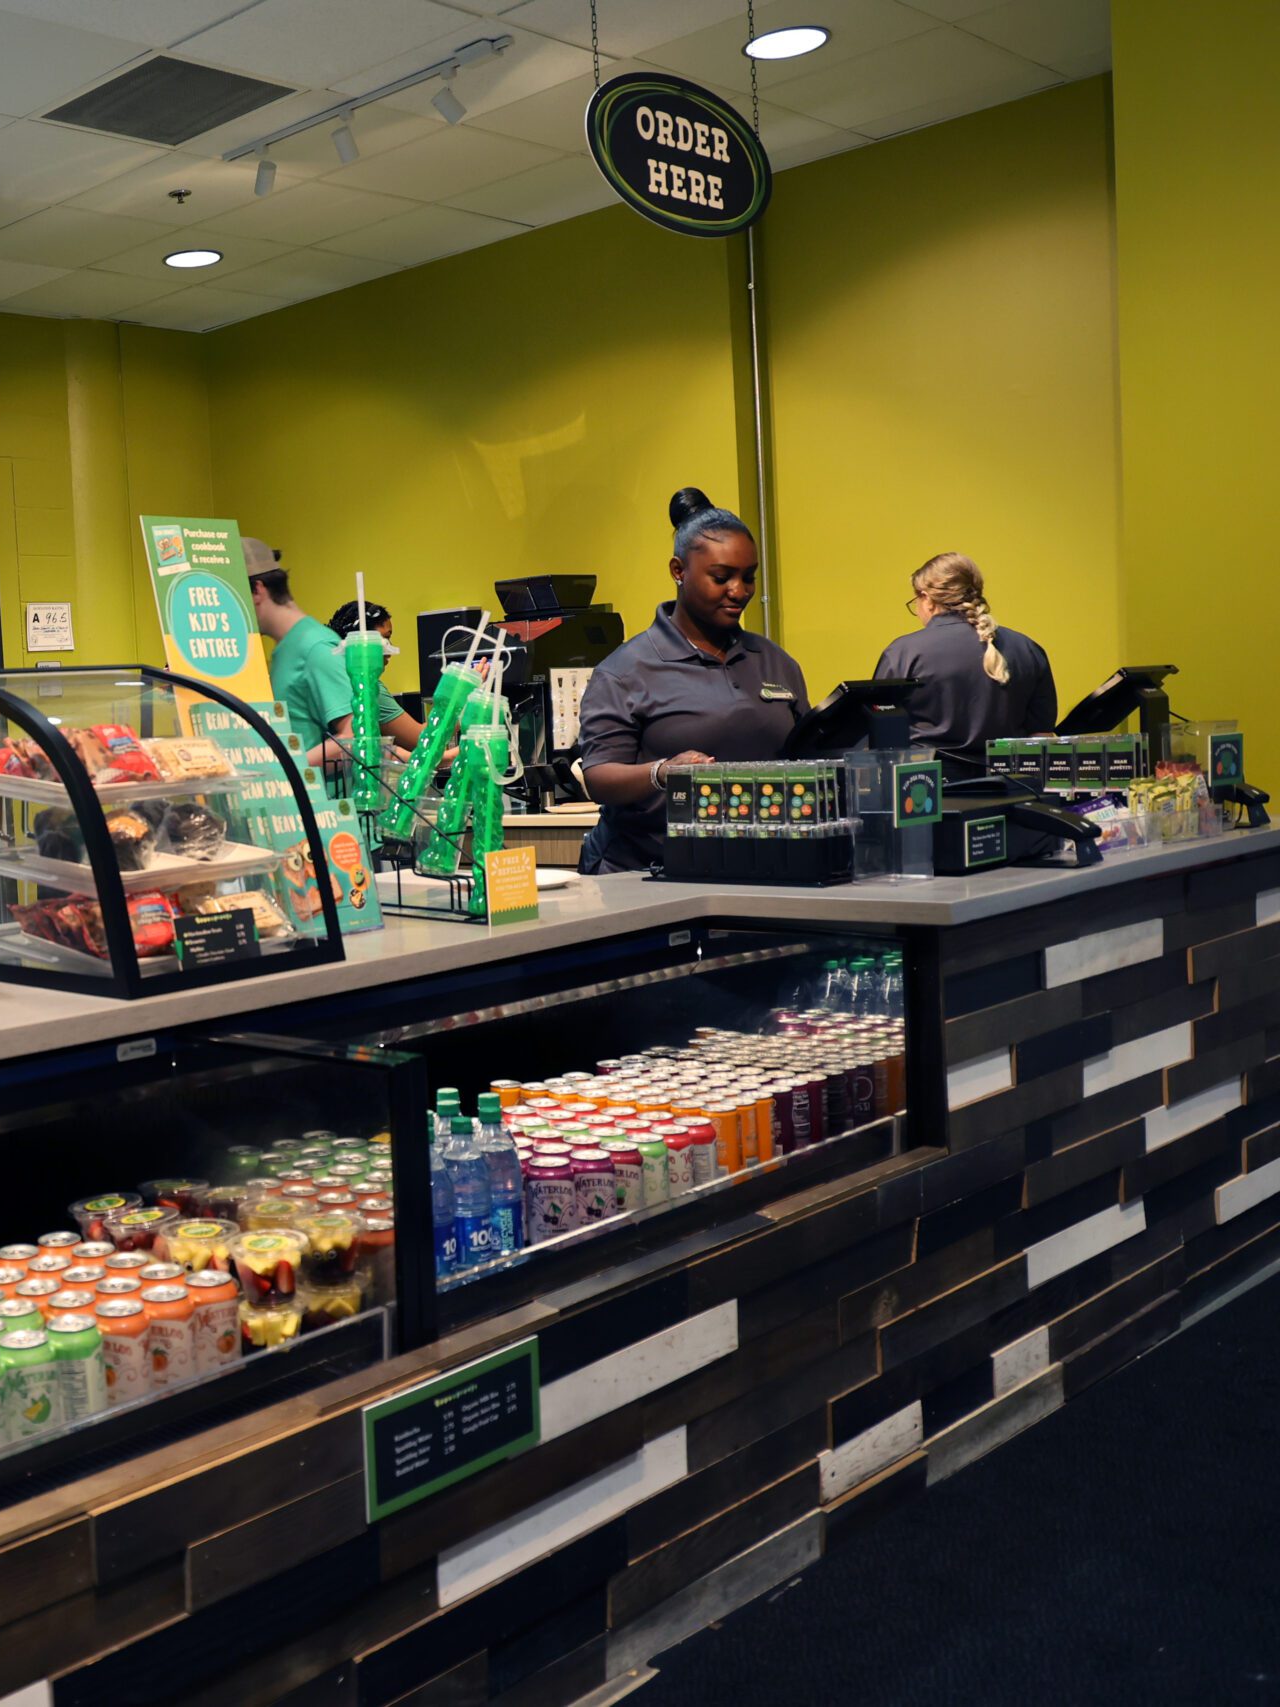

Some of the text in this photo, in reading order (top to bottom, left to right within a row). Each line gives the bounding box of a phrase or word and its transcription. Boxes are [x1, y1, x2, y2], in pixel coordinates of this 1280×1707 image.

[636, 105, 731, 163] ORDER
[647, 158, 724, 210] HERE
[183, 528, 214, 539] Purchase
[216, 531, 228, 539] our
[191, 542, 226, 552] cookbook
[199, 555, 223, 564] receive
[188, 587, 220, 607] FREE
[32, 613, 40, 623] A
[188, 612, 230, 632] KID'S
[188, 638, 240, 659] ENTREE
[205, 711, 230, 730] BEAN
[272, 815, 296, 834] BEAN
